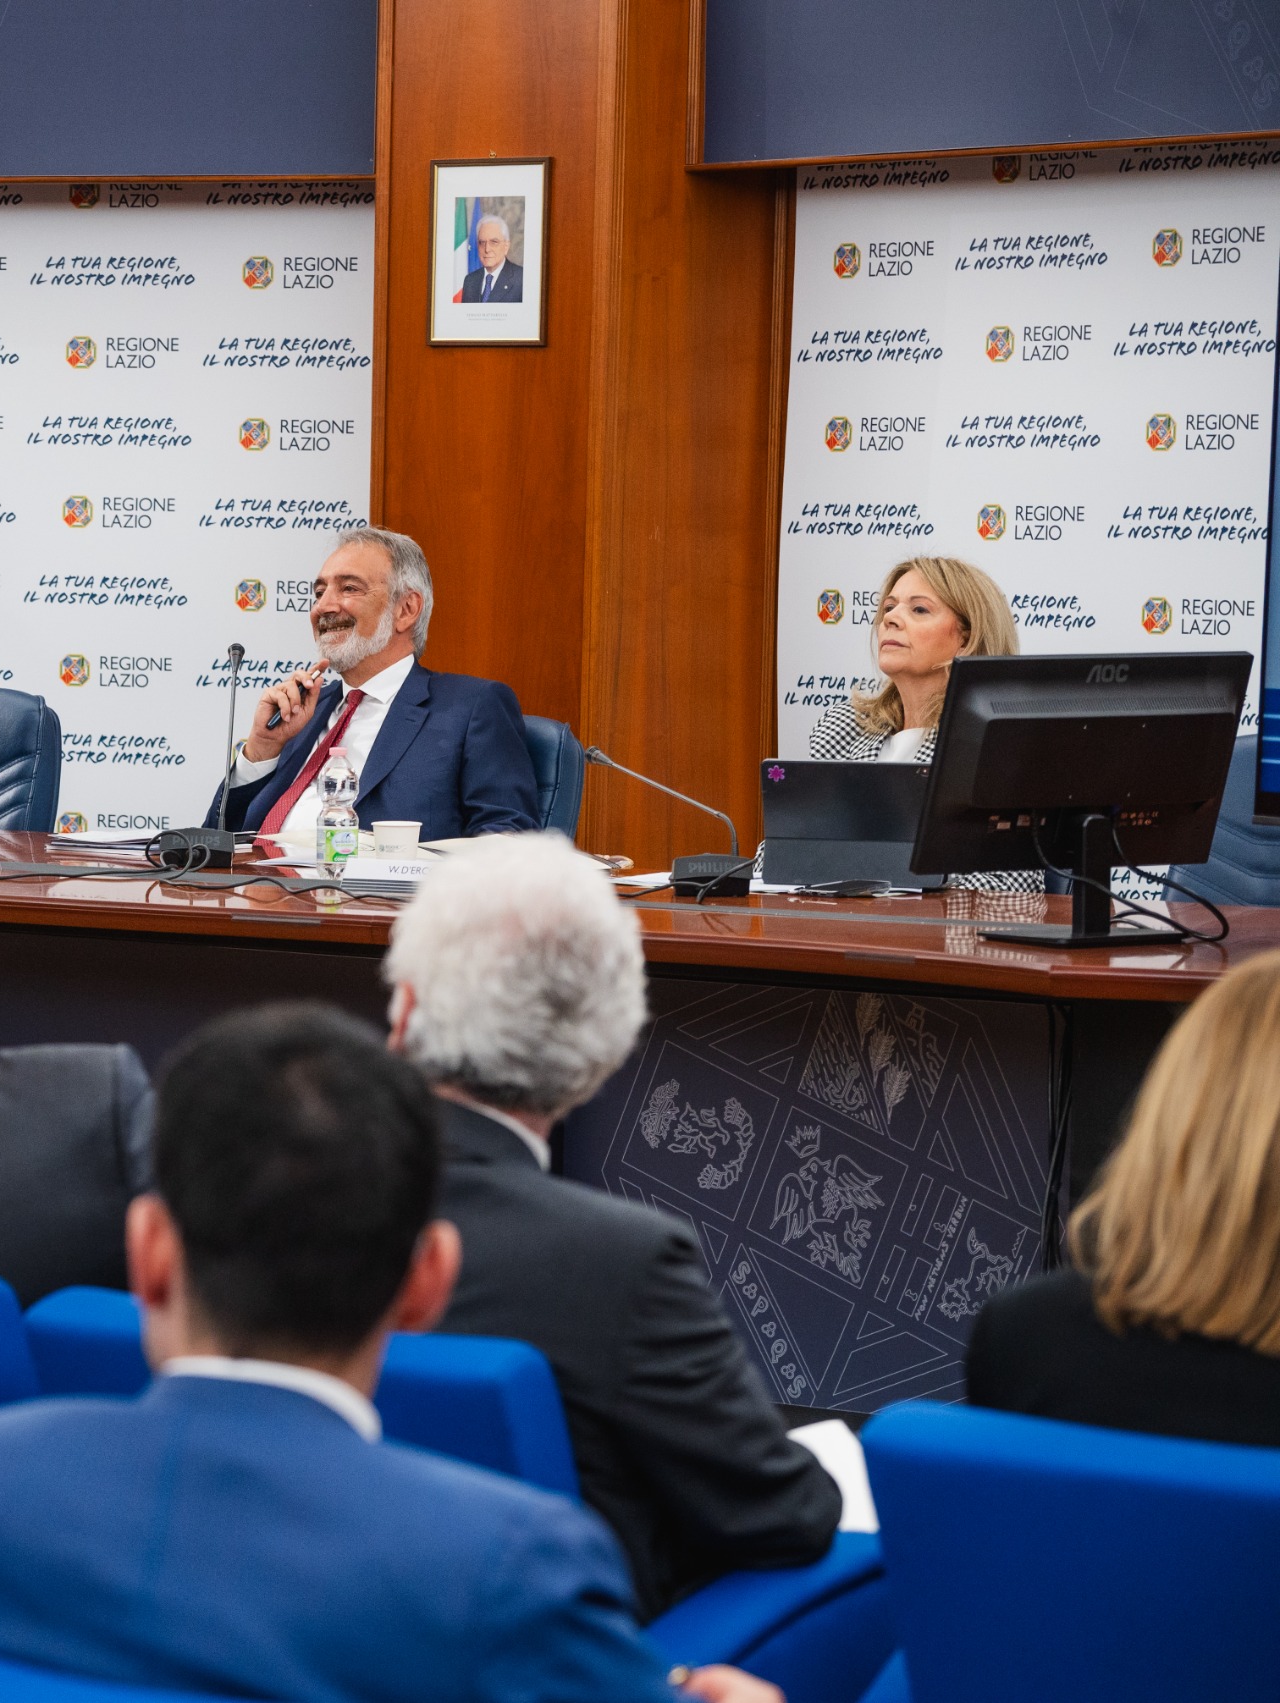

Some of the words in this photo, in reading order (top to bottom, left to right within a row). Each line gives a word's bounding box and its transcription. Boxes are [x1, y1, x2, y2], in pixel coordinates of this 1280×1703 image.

[803, 176, 819, 191] IL
[821, 173, 880, 190] NOSTRO
[882, 169, 950, 188] IMPEGNO
[108, 193, 160, 209] LAZIO
[1191, 225, 1266, 246] REGIONE
[868, 240, 935, 259] REGIONE
[1191, 246, 1241, 265] LAZIO
[45, 256, 66, 270] LA
[71, 256, 102, 270] TUA
[106, 256, 181, 273] REGIONE,
[283, 256, 359, 272] REGIONE
[868, 260, 913, 278] LAZIO
[29, 272, 47, 286] IL
[50, 272, 116, 287] NOSTRO
[120, 272, 196, 290] IMPEGNO
[283, 274, 335, 290] LAZIO
[811, 330, 829, 345] LA
[833, 329, 861, 345] TUA
[864, 328, 930, 347] REGIONE,
[1023, 324, 1092, 342] REGIONE
[106, 337, 180, 352] REGIONE
[1022, 344, 1070, 362] LAZIO
[105, 354, 156, 369] LAZIO
[796, 349, 813, 363] IL
[815, 348, 873, 363] NOSTRO
[876, 346, 943, 365] IMPEGNO
[42, 415, 62, 429] LA
[67, 416, 99, 430] TUA
[103, 416, 177, 433] REGIONE,
[280, 419, 355, 435] REGIONE
[860, 416, 926, 433] REGIONE
[960, 415, 980, 431] LA
[984, 415, 1013, 431] TUA
[1016, 414, 1087, 433] REGIONE,
[1185, 413, 1260, 431] REGIONE
[26, 432, 43, 445] IL
[47, 432, 113, 447] NOSTRO
[117, 433, 192, 450] IMPEGNO
[279, 436, 331, 452] LAZIO
[859, 435, 904, 452] LAZIO
[945, 434, 961, 448] IL
[964, 433, 1026, 449] NOSTRO
[1030, 433, 1101, 452] IMPEGNO
[1185, 433, 1235, 451] LAZIO
[102, 496, 176, 513] REGIONE
[1015, 505, 1085, 522] REGIONE
[102, 513, 152, 529] LAZIO
[1014, 524, 1063, 541] LAZIO
[38, 574, 59, 588] LA
[64, 575, 95, 589] TUA
[99, 575, 173, 593] REGIONE,
[276, 580, 313, 596] REGI
[23, 590, 40, 603] IL
[44, 591, 110, 606] NOSTRO
[113, 592, 188, 610] IMPEGNO
[276, 597, 317, 613] LAZI
[1010, 593, 1082, 613] REGIONE,
[1181, 598, 1256, 617] REGIONE
[1024, 613, 1096, 632] IMPEGNO
[1181, 618, 1231, 636] LAZIO
[99, 655, 173, 672] REGIONE
[211, 658, 232, 671] LA
[239, 659, 269, 673] TUA
[99, 672, 149, 689] LAZIO
[796, 674, 815, 690] LA
[818, 675, 846, 691] TUA
[1085, 663, 1130, 684] AOC
[784, 691, 800, 705] IL
[61, 733, 93, 747] TUA
[97, 734, 171, 752] REGIONE,
[60, 751, 107, 766] OSTRO
[111, 751, 186, 769] IMPEGNO
[96, 814, 170, 830] REGIONE
[401, 866, 431, 875] D'ERC
[1111, 868, 1131, 884] LA
